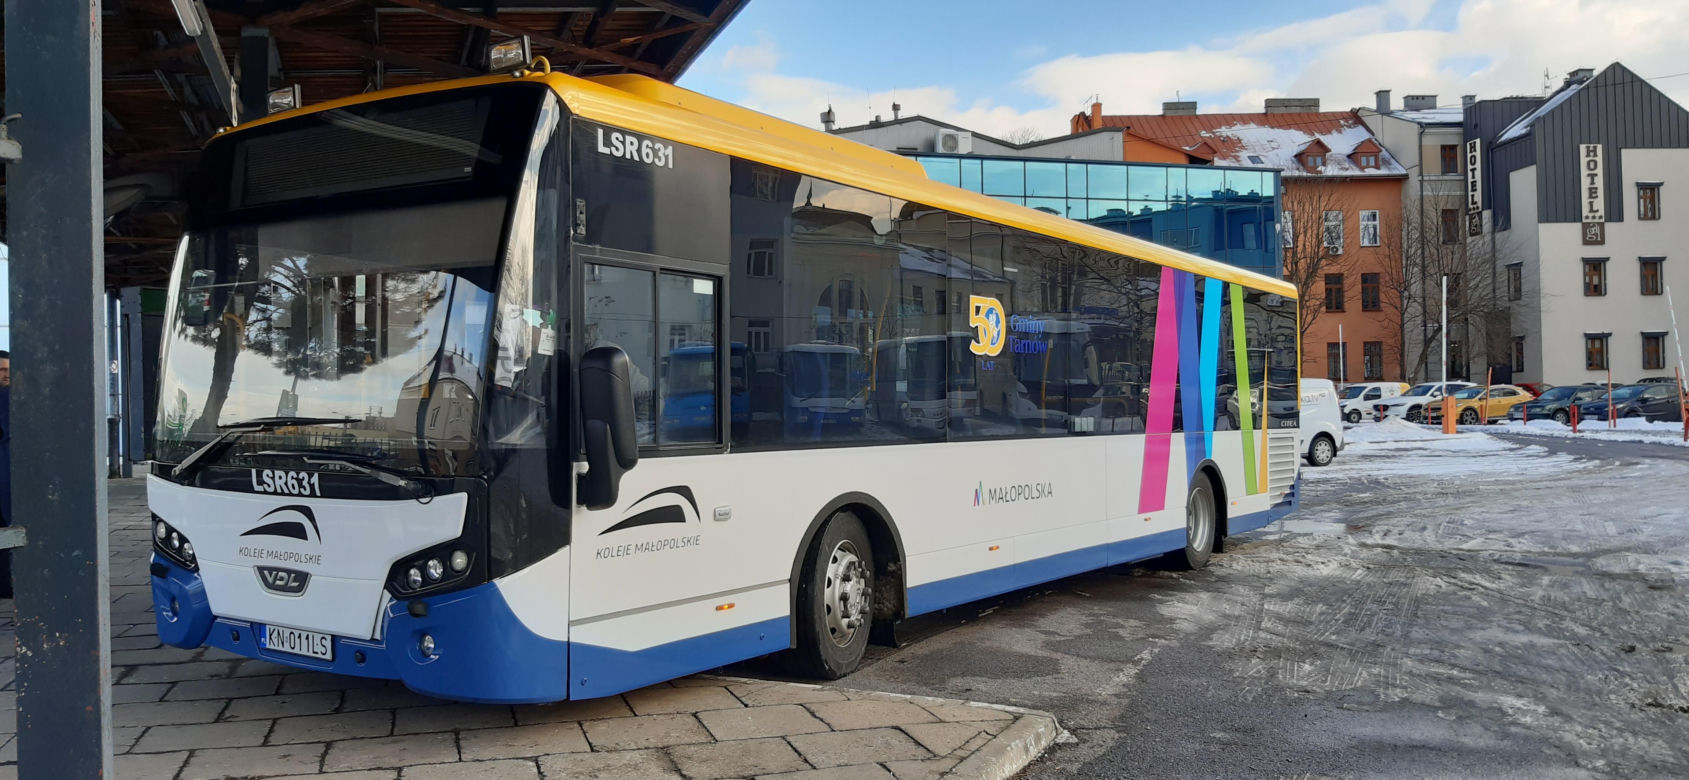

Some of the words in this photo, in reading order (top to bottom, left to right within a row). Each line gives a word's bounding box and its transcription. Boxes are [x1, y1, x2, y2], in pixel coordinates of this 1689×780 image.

[597, 128, 674, 169] LSR631
[1469, 141, 1478, 206] HOTEL
[1585, 145, 1599, 214] HOTEL
[969, 295, 1006, 356] 50
[1010, 314, 1044, 338] Gminy
[1008, 335, 1048, 353] Tarnów
[251, 468, 321, 496] LSR631
[988, 481, 1053, 505] MAŁOPOLSKA
[239, 546, 265, 559] KOLEJE
[266, 549, 322, 565] MAŁOPOLSKIE
[596, 543, 632, 560] KOLEJE
[634, 534, 701, 554] MAŁOPOLSKIE
[263, 570, 300, 587] VDL
